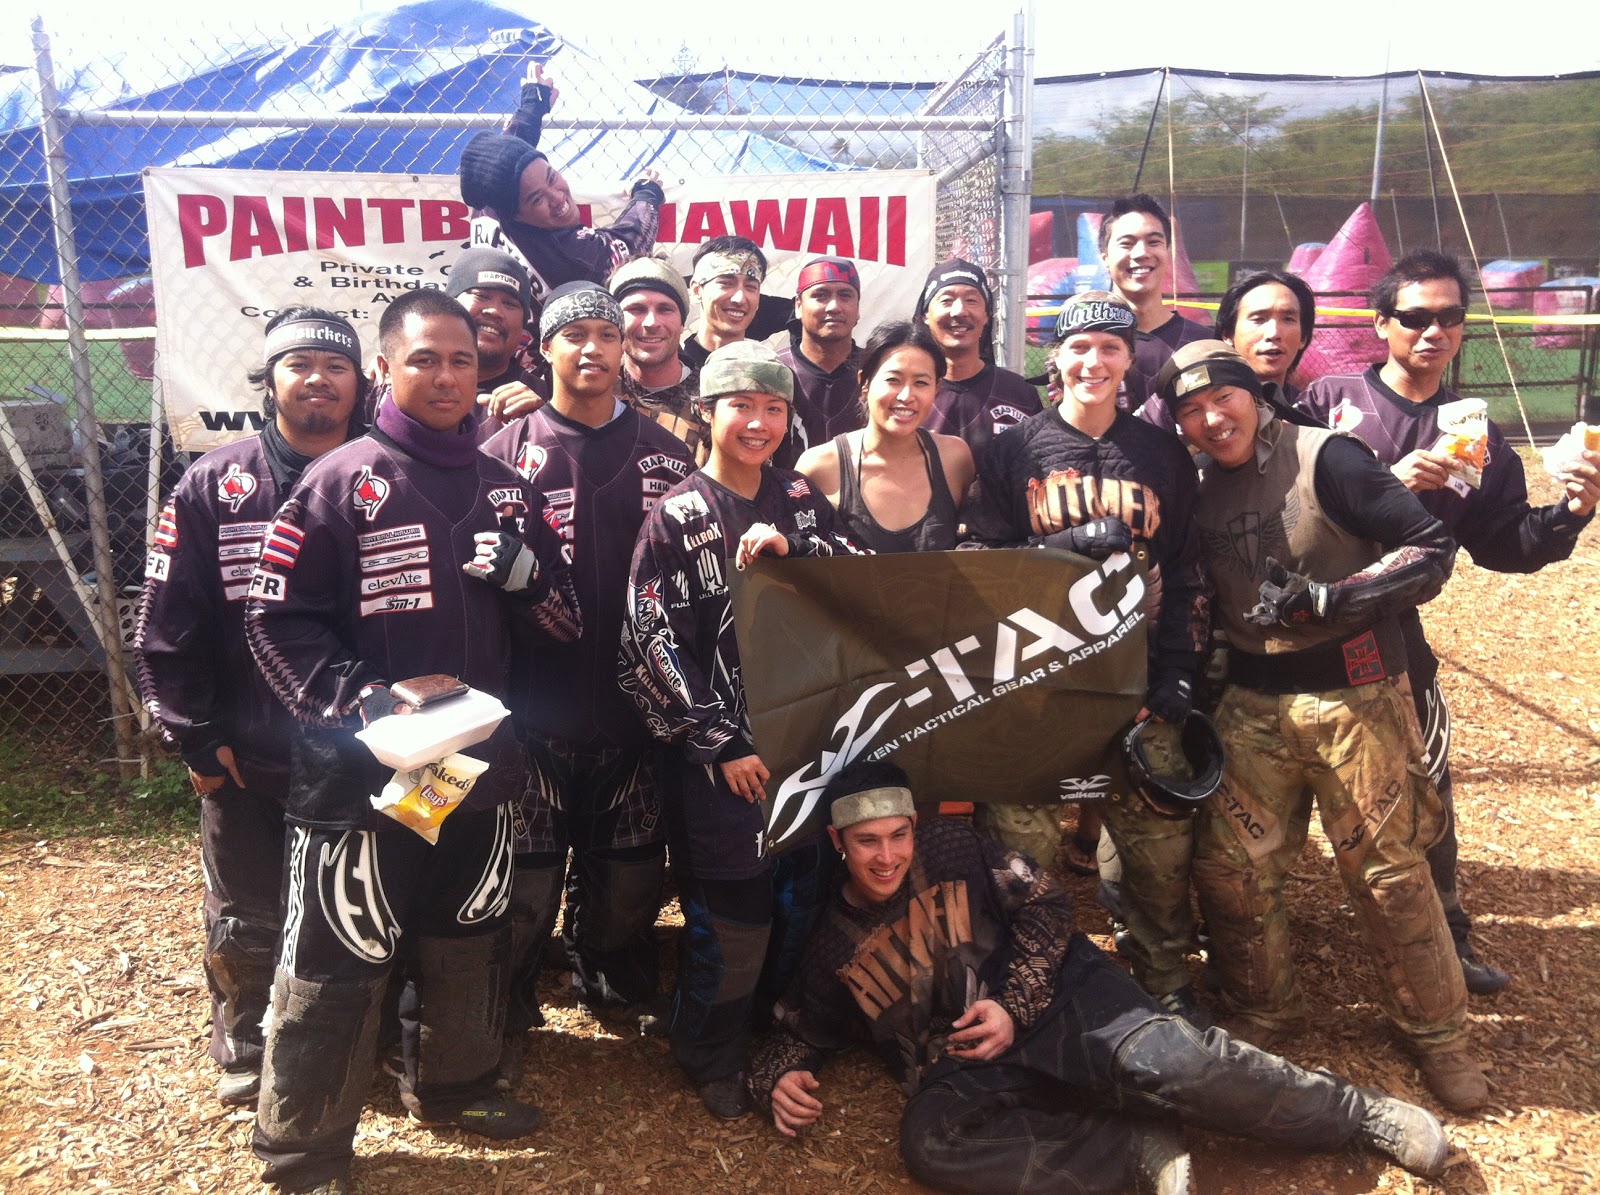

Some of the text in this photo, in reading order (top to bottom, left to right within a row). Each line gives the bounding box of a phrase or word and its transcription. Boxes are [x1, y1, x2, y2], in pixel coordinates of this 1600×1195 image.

[177, 193, 592, 269] PAINTB
[320, 261, 425, 276] Private
[293, 276, 314, 288] &
[641, 456, 688, 476] RAPTUR
[251, 573, 281, 596] FR
[901, 692, 991, 743] TACTICAL
[992, 669, 1046, 698] GEAR
[1049, 660, 1064, 673] &
[1068, 611, 1146, 665] APPAREL
[1060, 791, 1107, 800] valken
